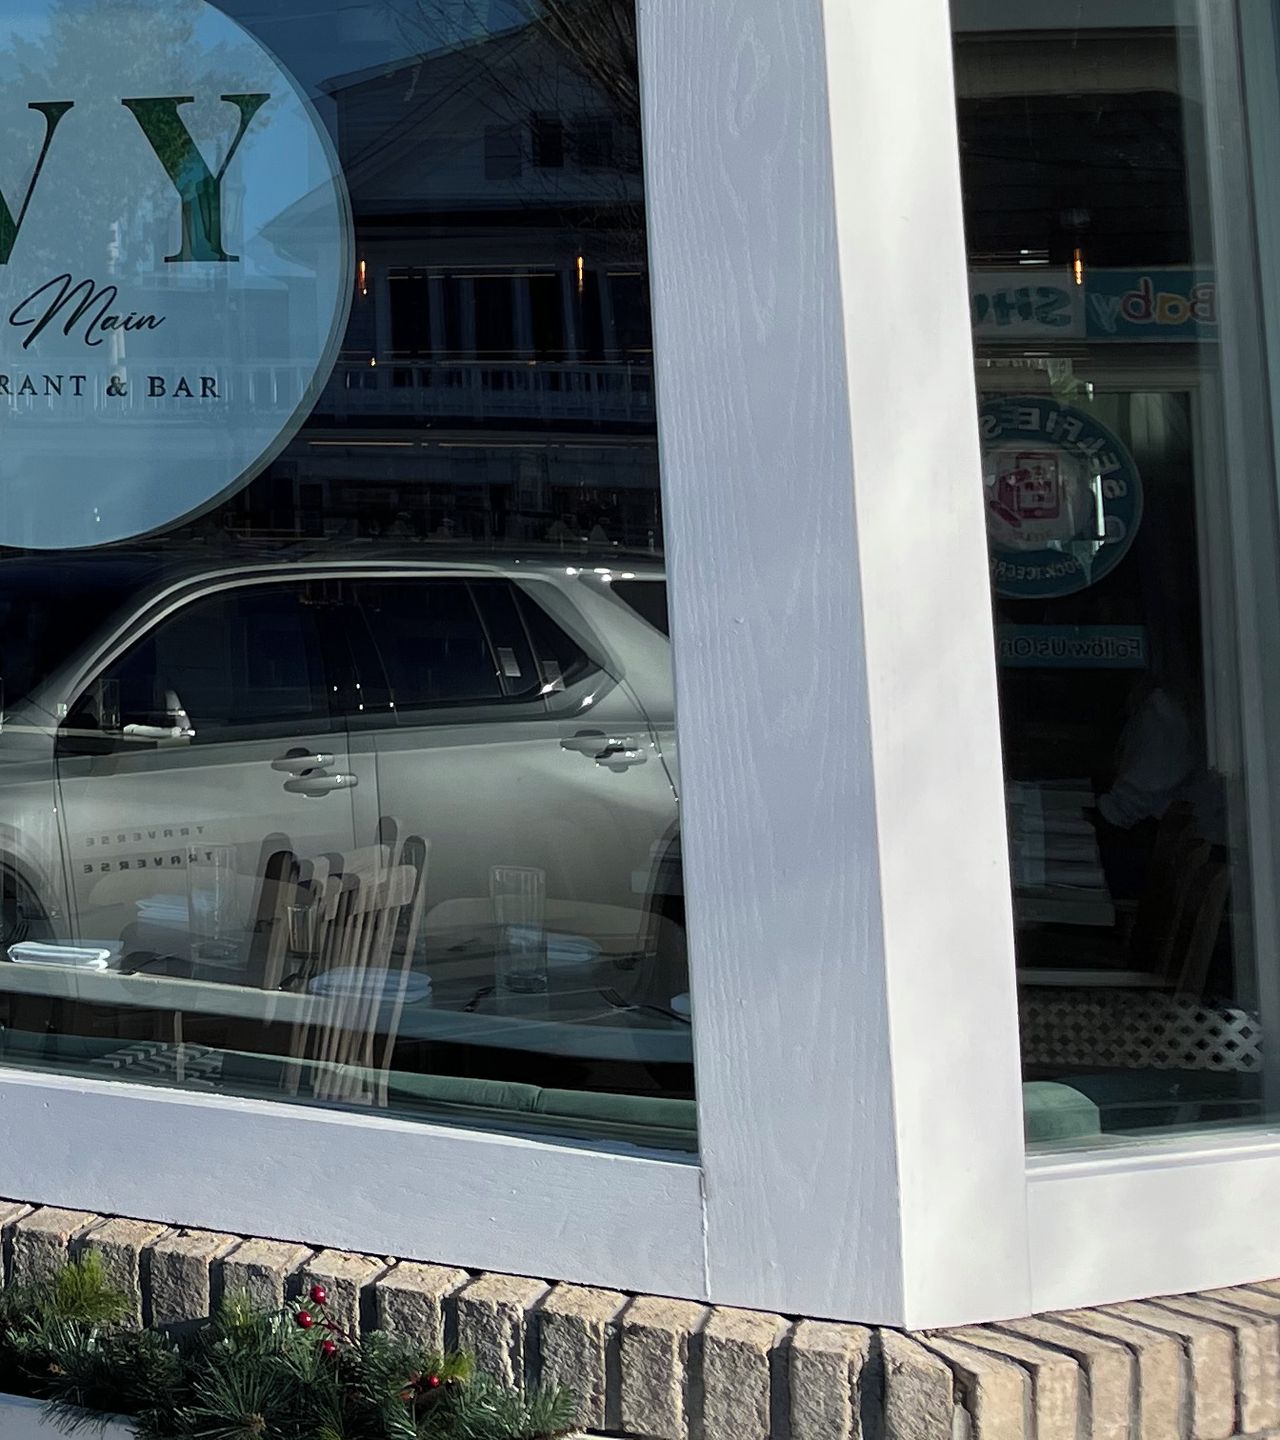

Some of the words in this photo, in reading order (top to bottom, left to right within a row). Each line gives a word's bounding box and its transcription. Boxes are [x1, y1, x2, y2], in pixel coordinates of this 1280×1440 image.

[8, 272, 166, 350] Main
[105, 375, 128, 399] &
[147, 375, 222, 399] BAR
